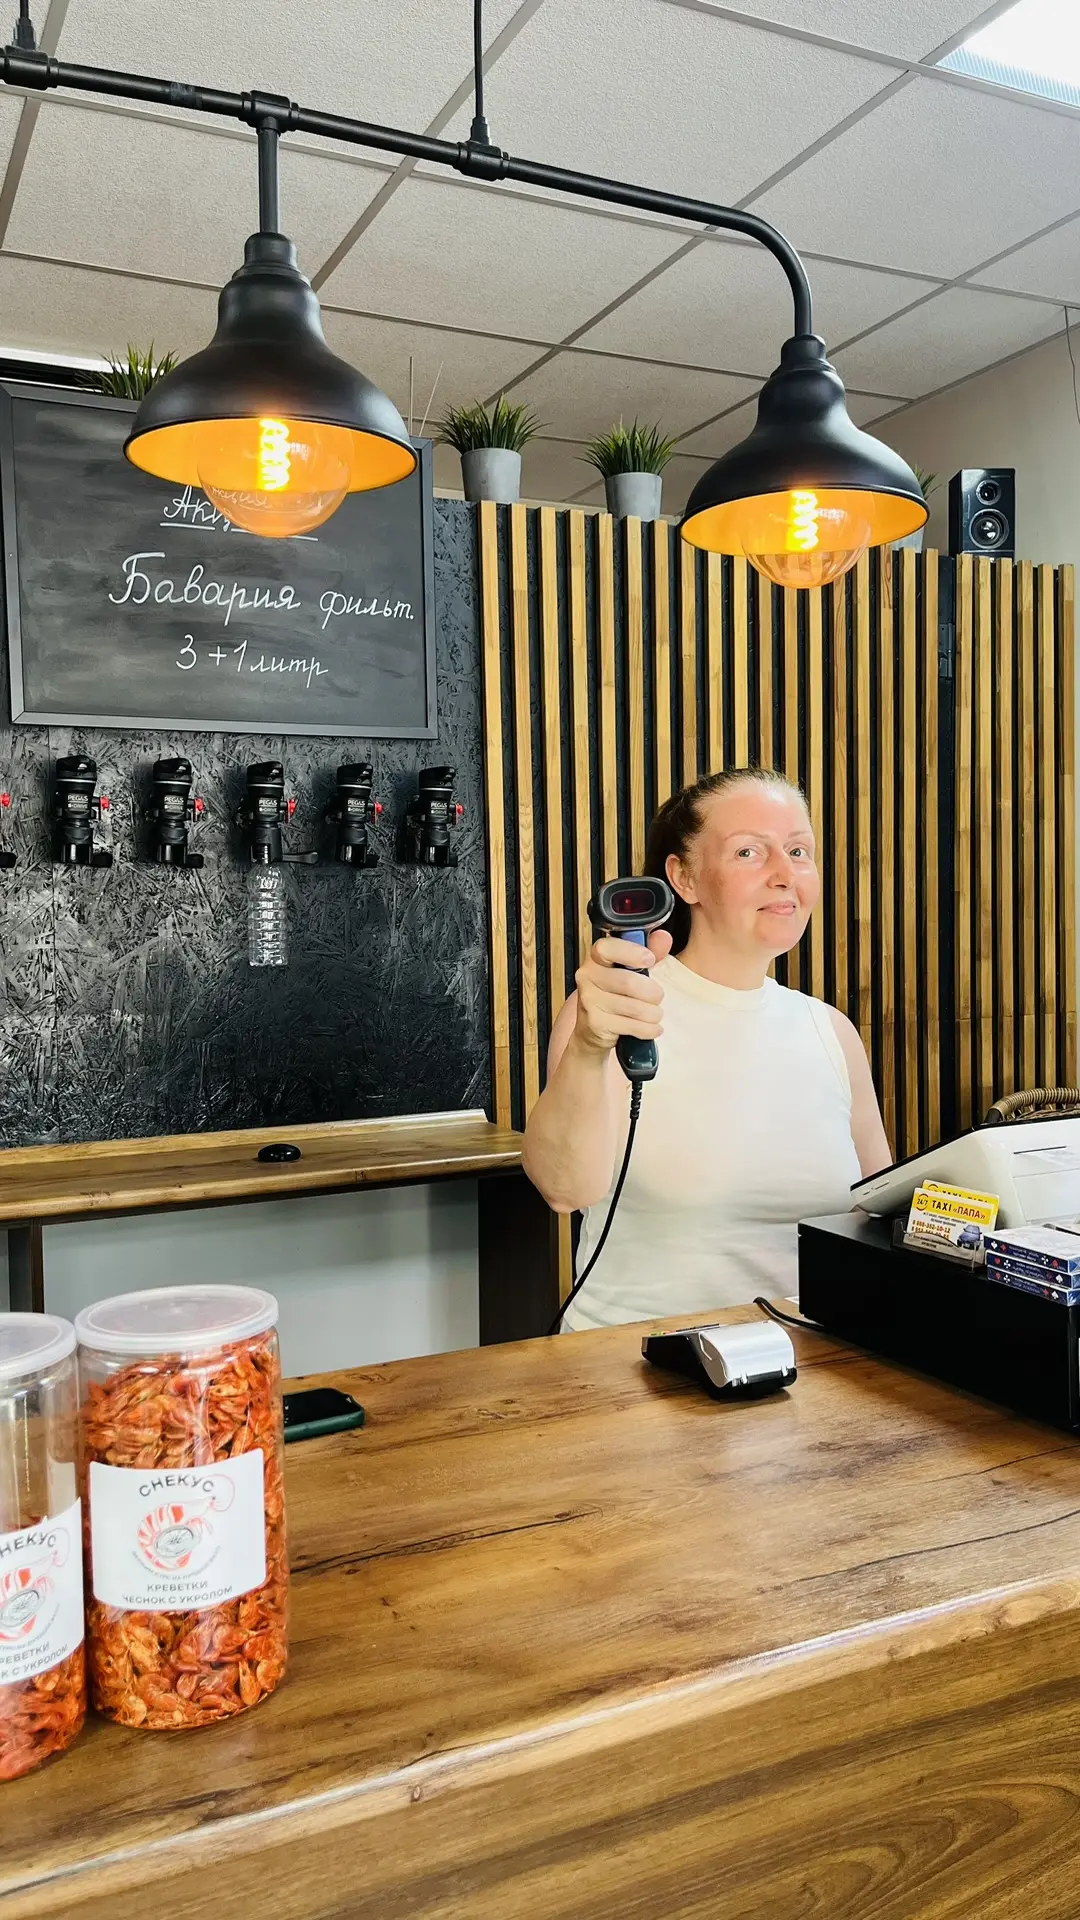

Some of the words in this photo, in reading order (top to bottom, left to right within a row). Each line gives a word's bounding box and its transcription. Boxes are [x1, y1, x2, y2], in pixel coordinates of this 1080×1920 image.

[108, 551, 301, 626] Бавария
[319, 590, 415, 630] фильт.
[931, 1199, 952, 1212] TAXI
[953, 1206, 986, 1220] «ПАПА»
[139, 1474, 215, 1498] СНЕКУС
[121, 1594, 167, 1605] ЧЕСНОК
[168, 1596, 177, 1604] С
[178, 1584, 233, 1604] УКРОПОМ
[146, 1580, 208, 1593] КРЕВЕТКИ
